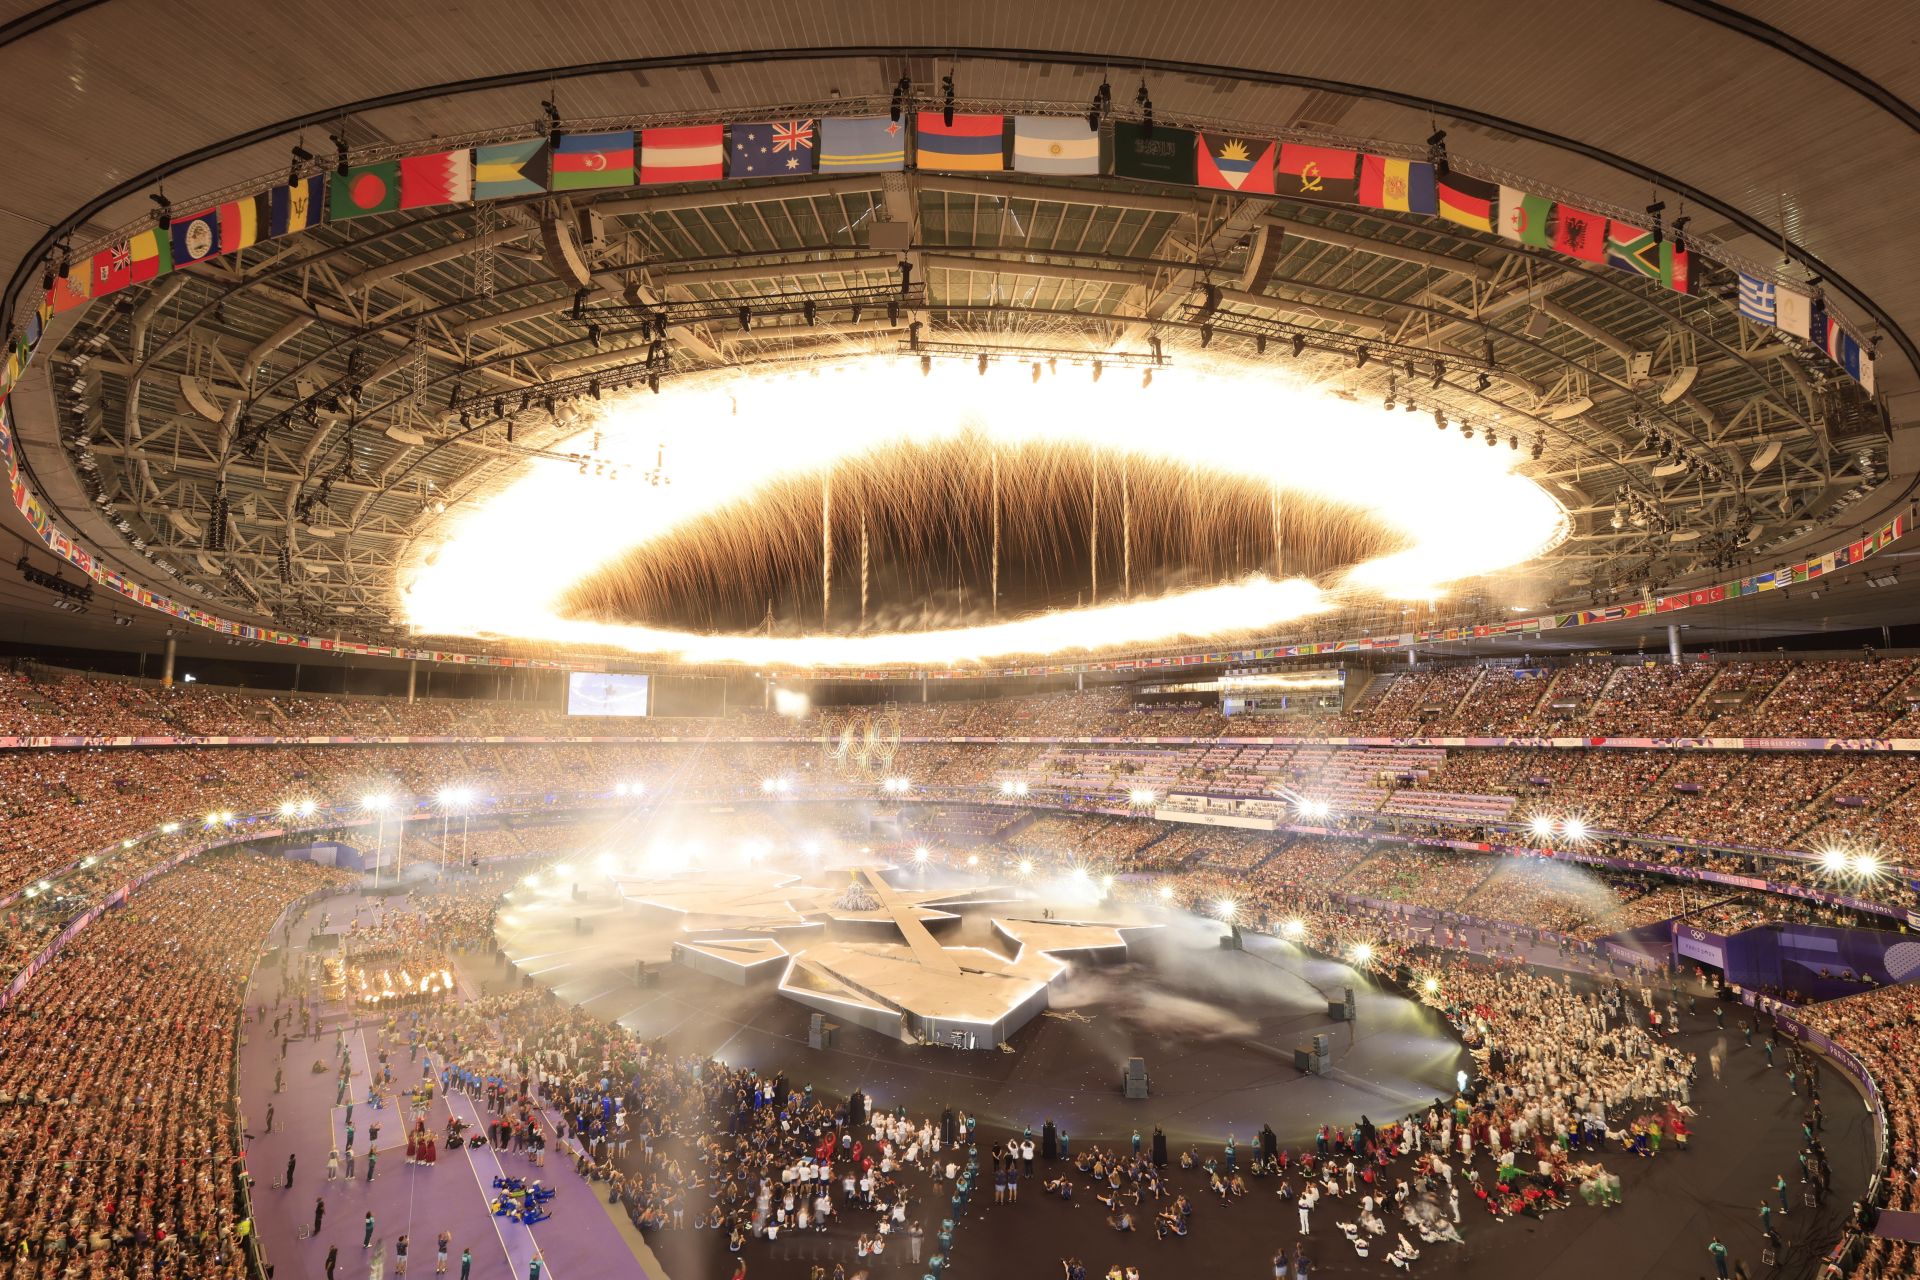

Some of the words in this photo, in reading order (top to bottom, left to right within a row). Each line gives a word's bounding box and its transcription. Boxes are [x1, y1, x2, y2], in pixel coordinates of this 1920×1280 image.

[1854, 900, 1874, 910] PARIS
[1875, 905, 1893, 914] 2024
[1519, 927, 1532, 935] 202
[1685, 943, 1700, 953] PARIS
[1700, 949, 1715, 958] 2024
[1829, 1045, 1847, 1063] PARIS
